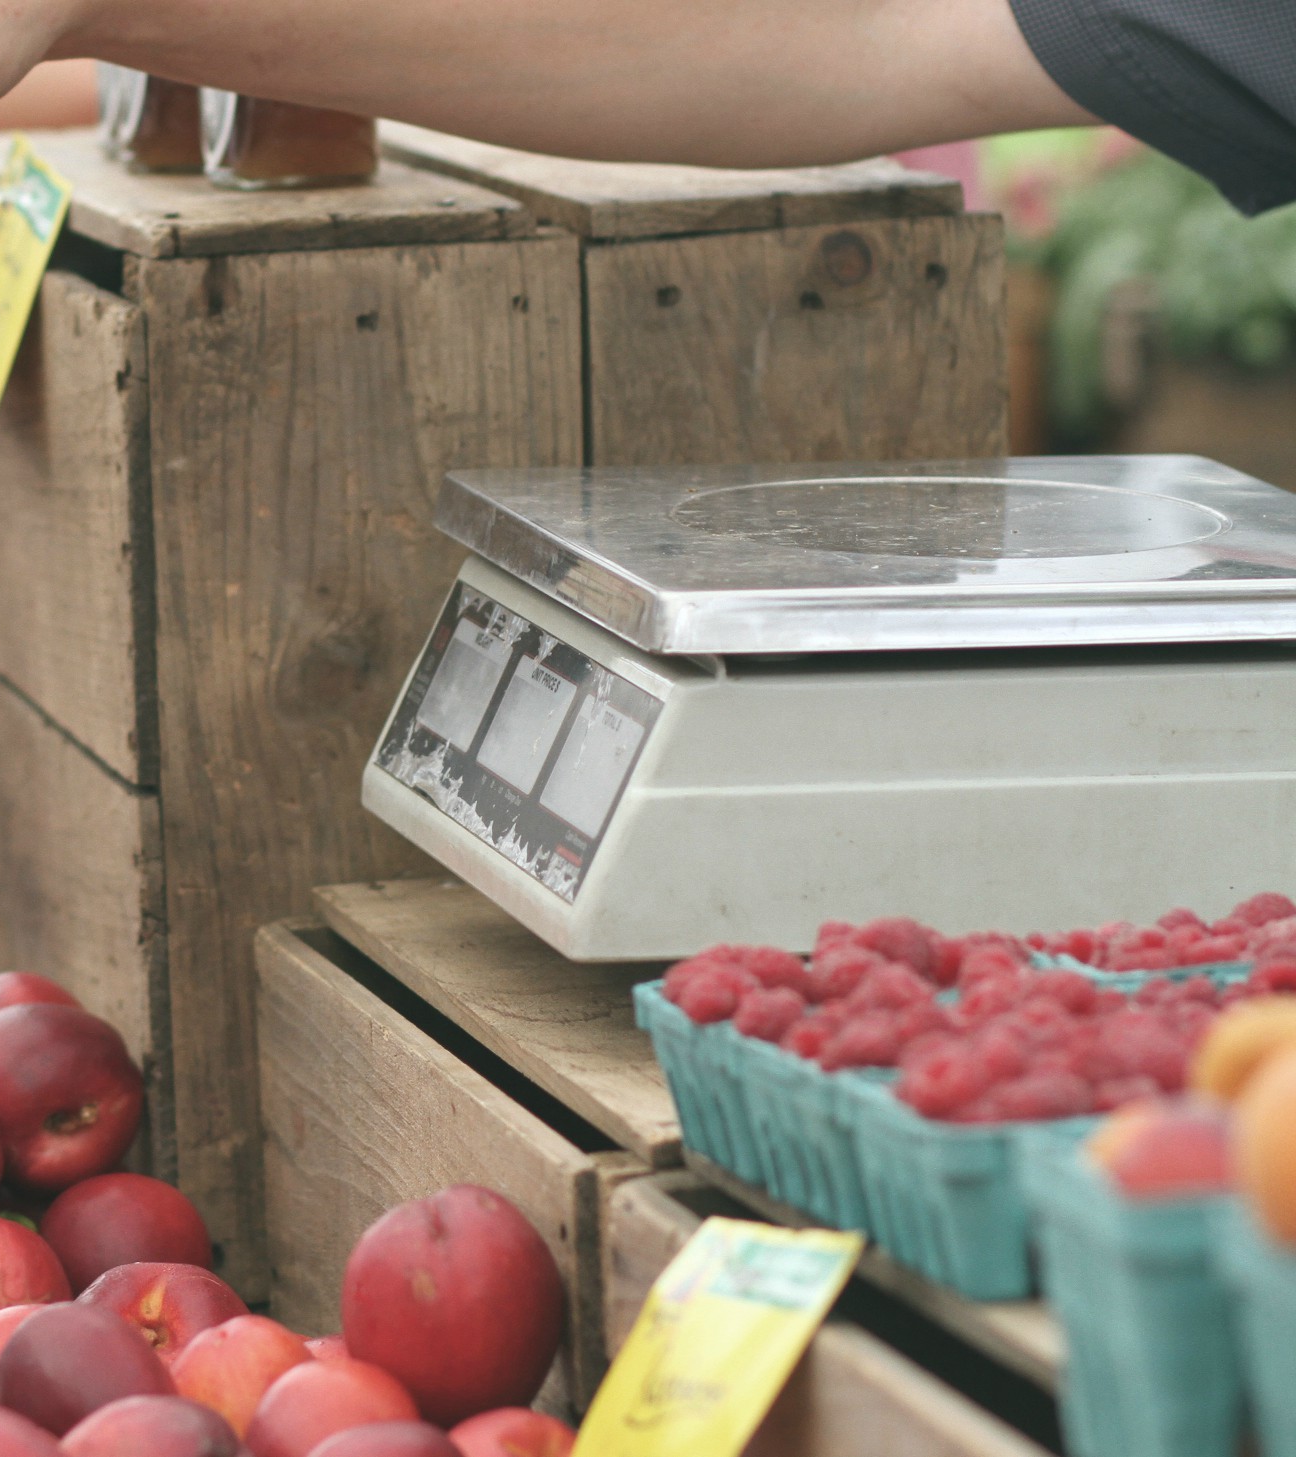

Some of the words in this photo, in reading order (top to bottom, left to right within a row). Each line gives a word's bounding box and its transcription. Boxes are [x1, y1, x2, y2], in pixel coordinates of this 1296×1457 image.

[531, 667, 545, 683] UNIT
[542, 672, 558, 691] PRICE
[554, 680, 561, 693] $
[602, 710, 617, 730] TOTAL
